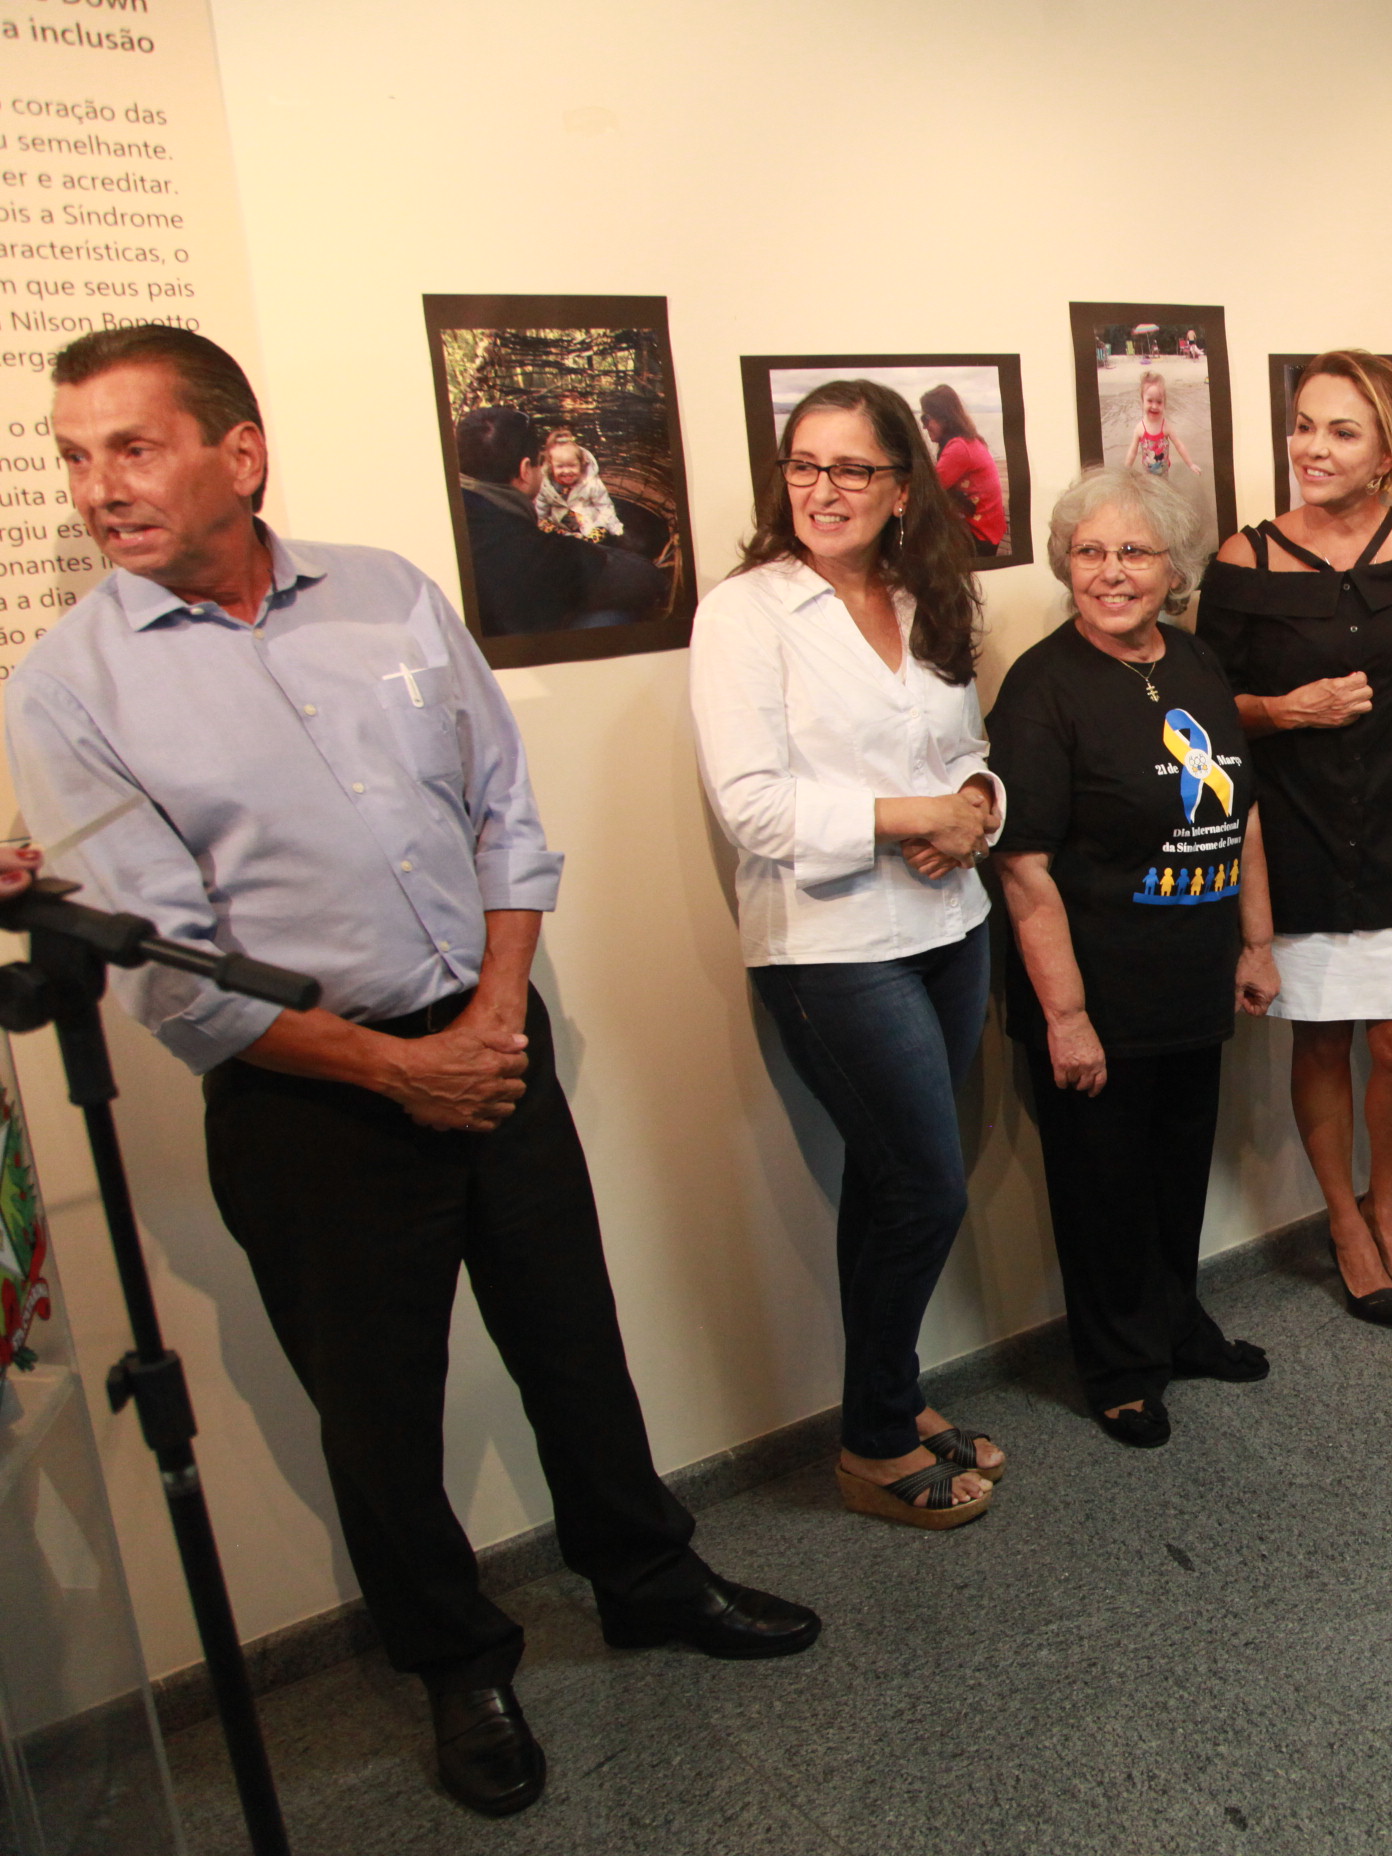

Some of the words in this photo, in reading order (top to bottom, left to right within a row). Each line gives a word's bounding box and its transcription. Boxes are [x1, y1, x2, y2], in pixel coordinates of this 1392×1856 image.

[29, 17, 155, 53] inclusão
[12, 98, 116, 124] coração
[125, 102, 167, 125] das
[18, 134, 173, 160] semelhante.
[38, 173, 52, 189] e
[63, 172, 179, 195] acreditar.
[41, 208, 54, 224] a
[63, 204, 184, 229] Síndrome
[174, 248, 190, 263] o
[26, 279, 76, 301] que
[84, 281, 139, 297] seus
[147, 278, 196, 302] pais
[11, 311, 93, 333] Nilson
[9, 422, 25, 437] o
[18, 595, 31, 610] a
[40, 587, 77, 608] dia
[1155, 764, 1167, 775] 21
[1167, 763, 1179, 774] de
[1173, 829, 1190, 837] Dia
[1191, 819, 1240, 837] Internacional
[1162, 842, 1175, 852] da
[1177, 842, 1218, 852] Síndrome
[1219, 838, 1226, 848] de
